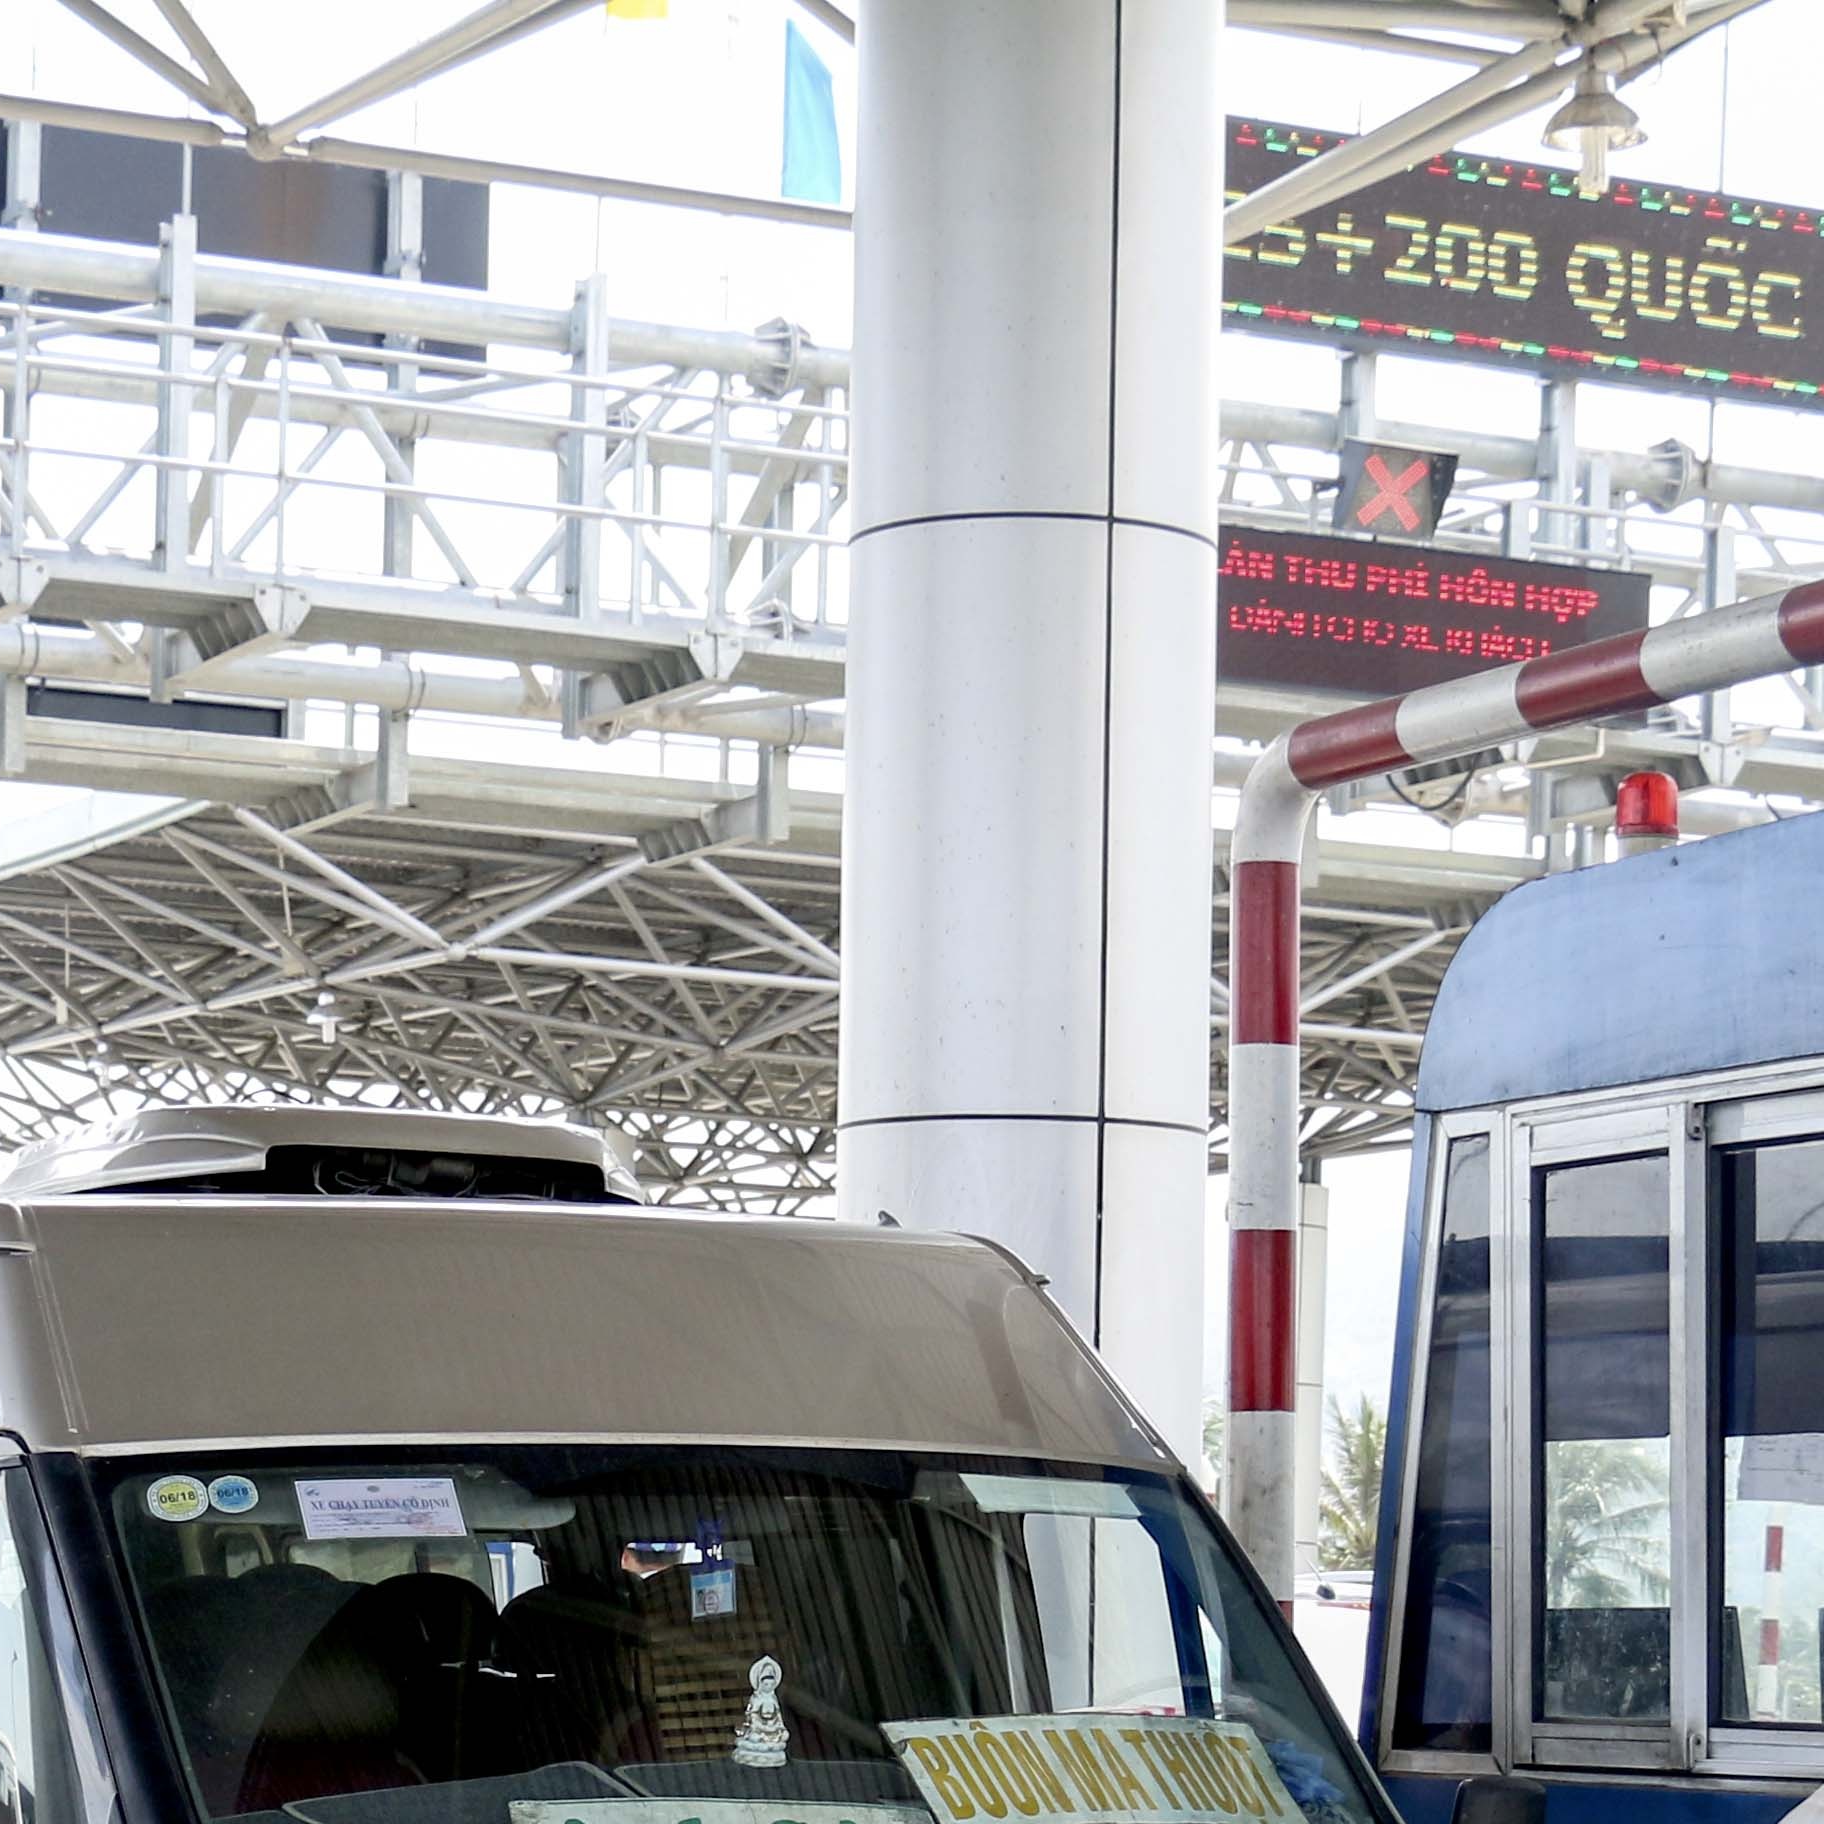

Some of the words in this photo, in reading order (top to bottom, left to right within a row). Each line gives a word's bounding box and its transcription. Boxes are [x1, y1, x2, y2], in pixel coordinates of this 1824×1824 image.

[1565, 238, 1805, 343] QUỐC
[1283, 554, 1357, 592] THU
[159, 1490, 196, 1504] 06/18
[909, 1720, 1076, 1821] BUÔN
[1041, 1728, 1159, 1813] MA
